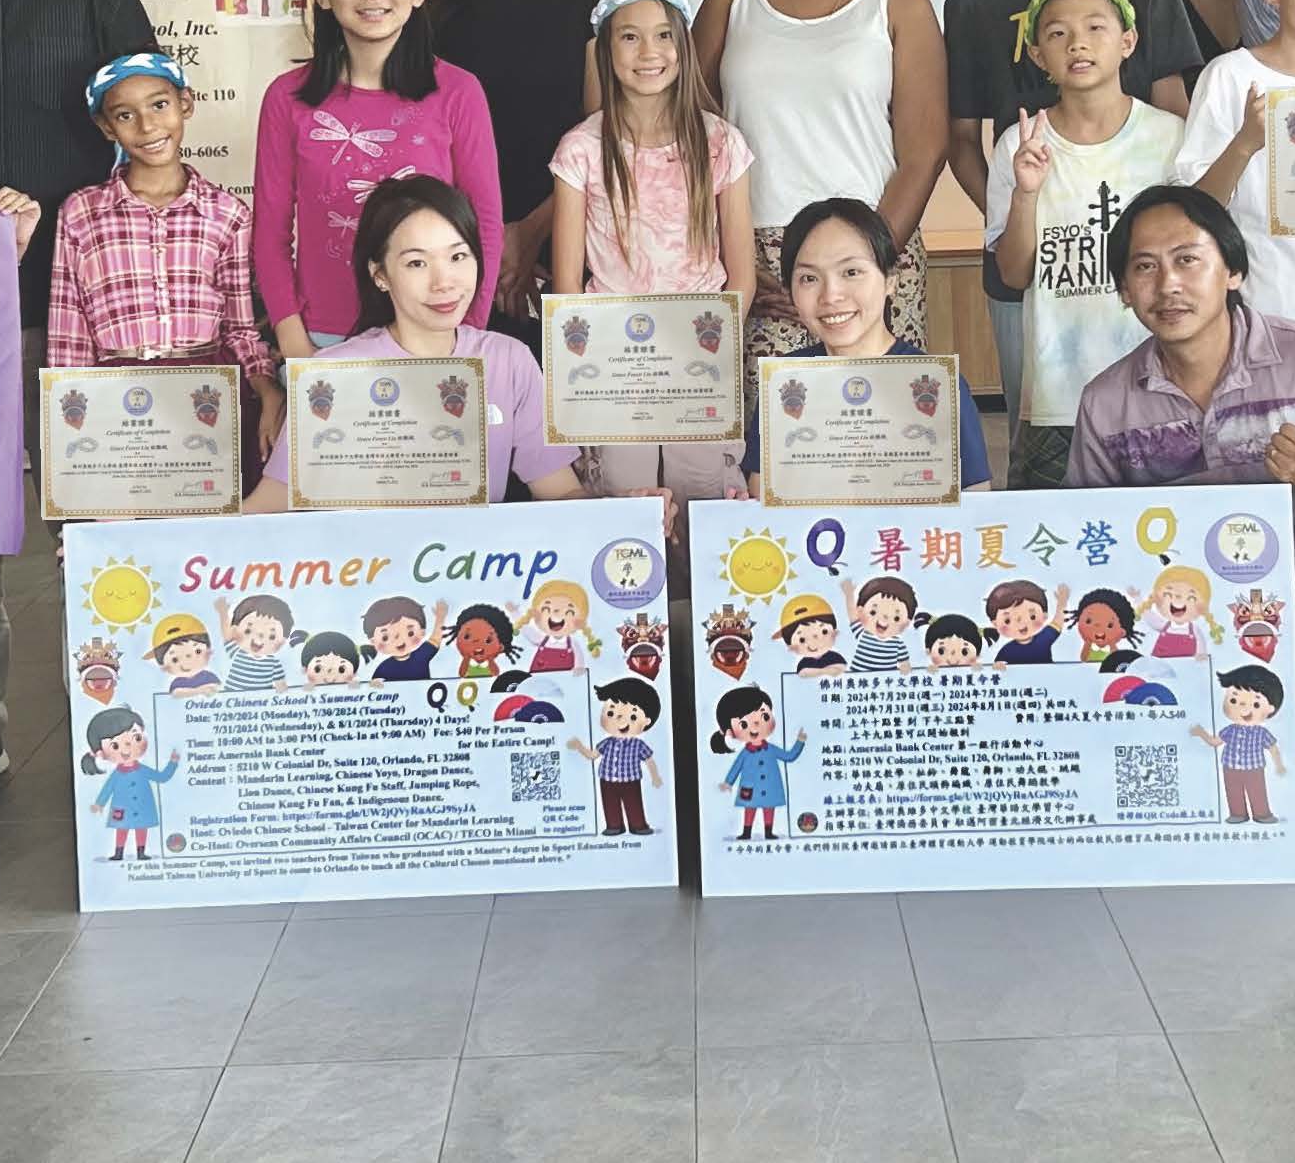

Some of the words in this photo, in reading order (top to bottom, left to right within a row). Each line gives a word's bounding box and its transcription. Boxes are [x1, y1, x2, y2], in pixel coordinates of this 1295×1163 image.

[185, 20, 218, 37] Inc.
[214, 89, 236, 101] 110
[1055, 286, 1101, 298] SUMMER
[870, 520, 1118, 572] 暑期夏令營
[179, 555, 391, 593] Summer
[413, 542, 558, 600] Camp
[185, 699, 222, 710] Oviedo
[225, 698, 268, 708] Chinese
[272, 695, 316, 705] School's
[319, 693, 364, 704] Summer
[368, 691, 399, 703] Camp
[475, 726, 491, 736] Per
[494, 725, 525, 735] Person
